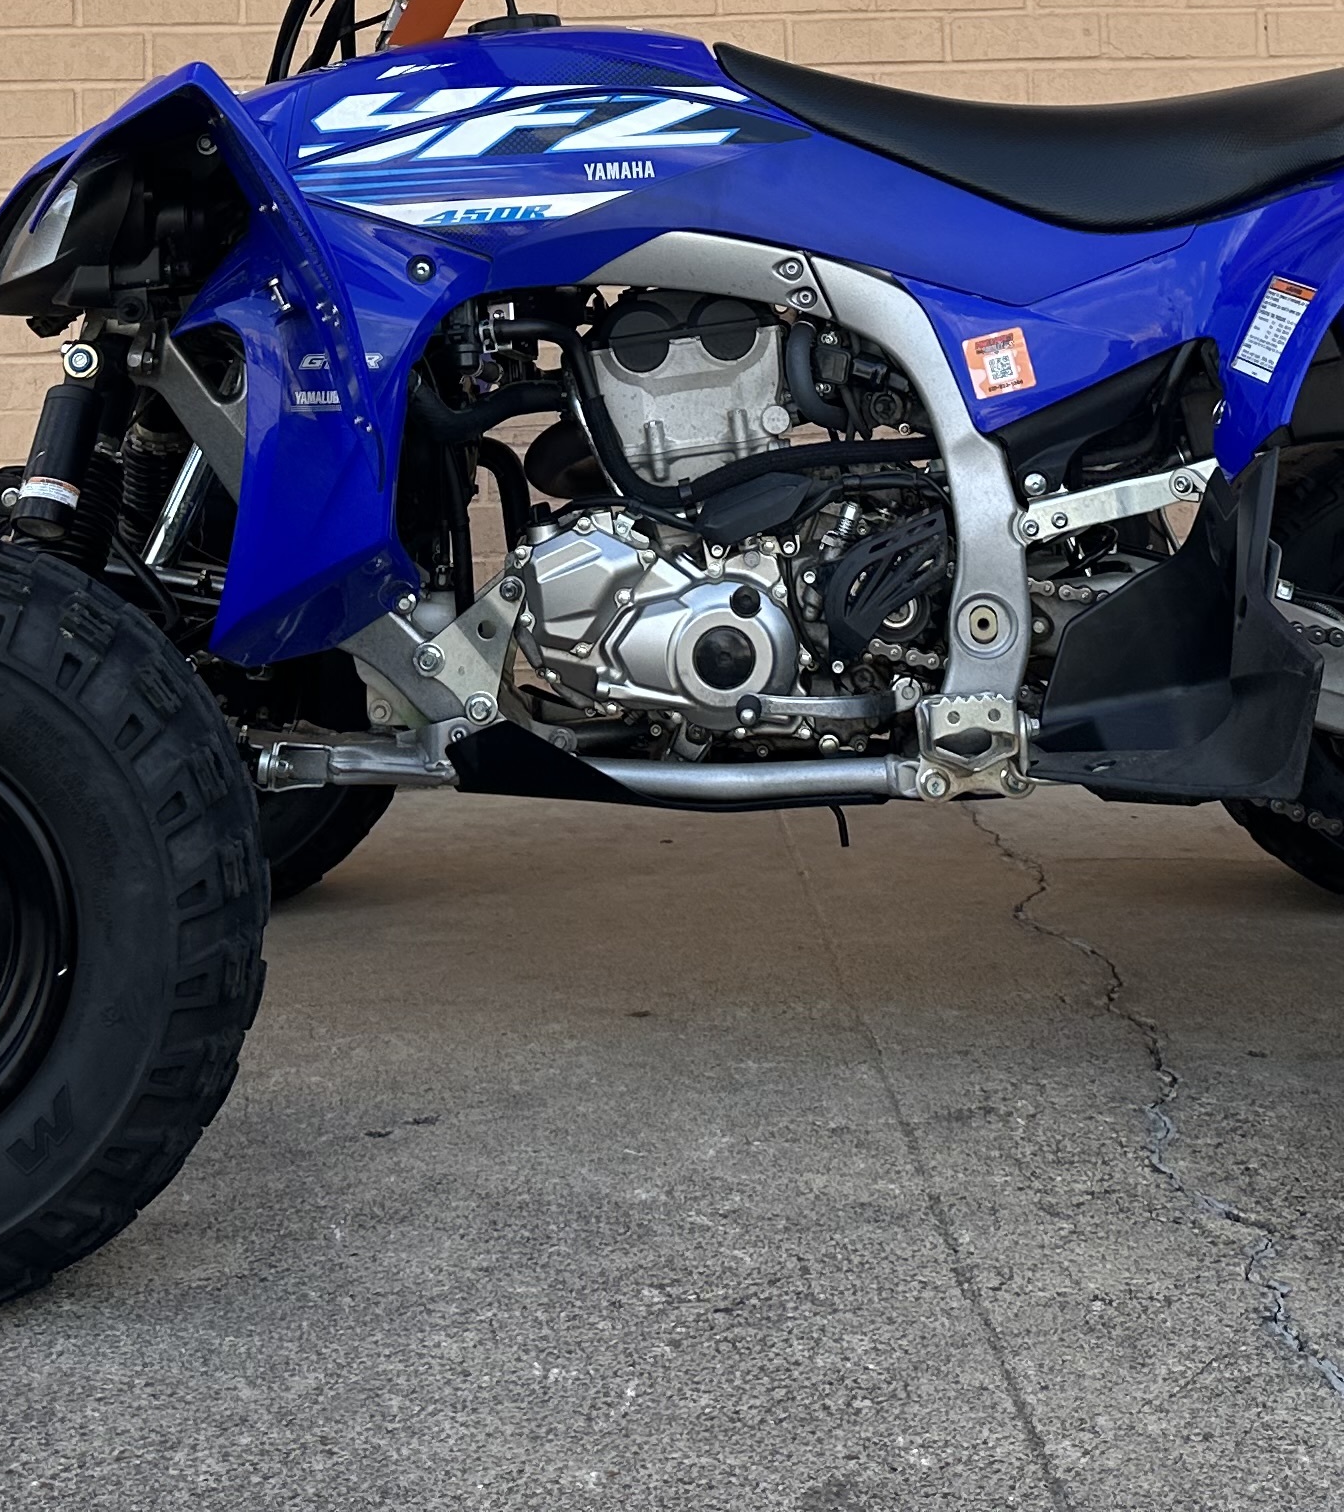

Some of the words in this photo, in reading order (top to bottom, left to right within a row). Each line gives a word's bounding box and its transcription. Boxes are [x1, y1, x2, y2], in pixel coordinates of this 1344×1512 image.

[583, 161, 656, 181] YAMAHA
[422, 203, 553, 226] 450R
[298, 352, 384, 370] GR
[294, 390, 341, 406] YAMALUB
